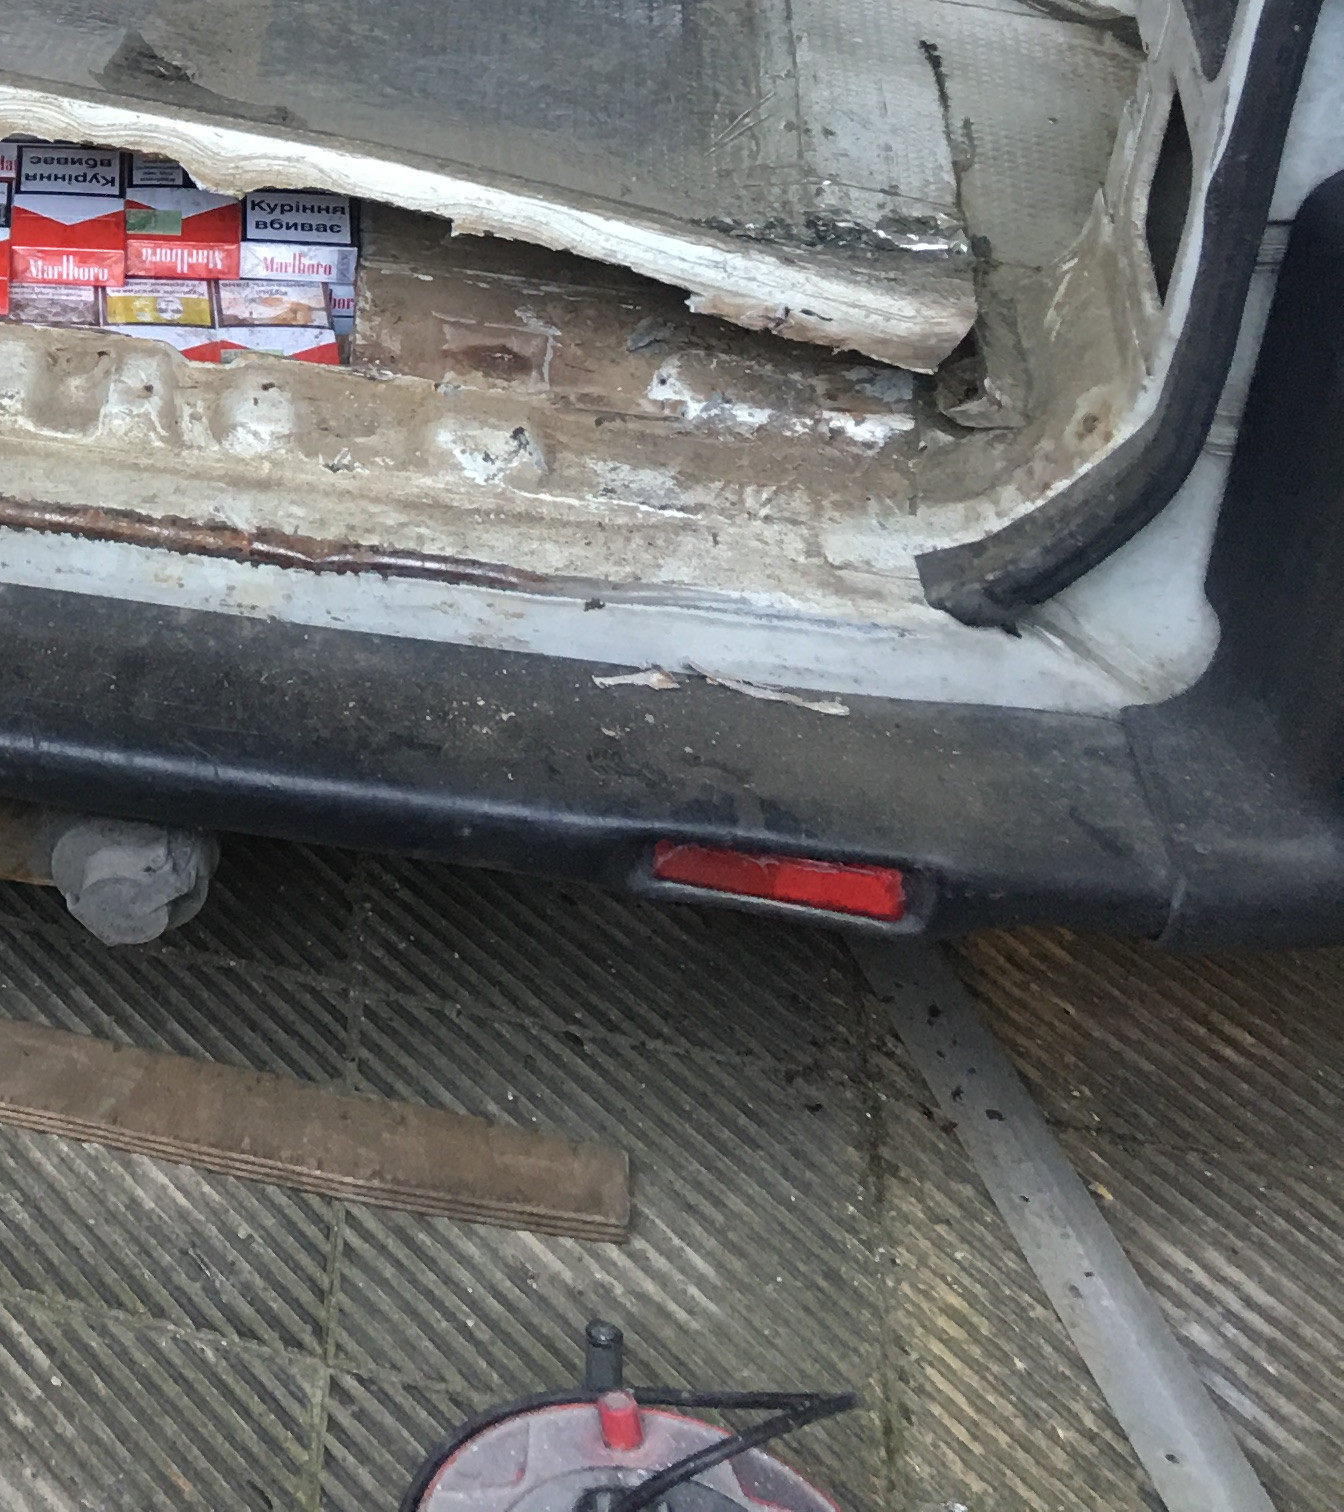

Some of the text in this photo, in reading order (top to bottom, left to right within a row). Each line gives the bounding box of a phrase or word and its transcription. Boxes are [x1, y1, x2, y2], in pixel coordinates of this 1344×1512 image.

[29, 155, 112, 168] вбиває
[25, 172, 116, 187] Куріння
[250, 199, 346, 216] Куріння
[254, 218, 342, 234] вбиває
[28, 254, 109, 281] Marlboro
[141, 246, 223, 274] Marlboro
[262, 251, 333, 276] Marlboro
